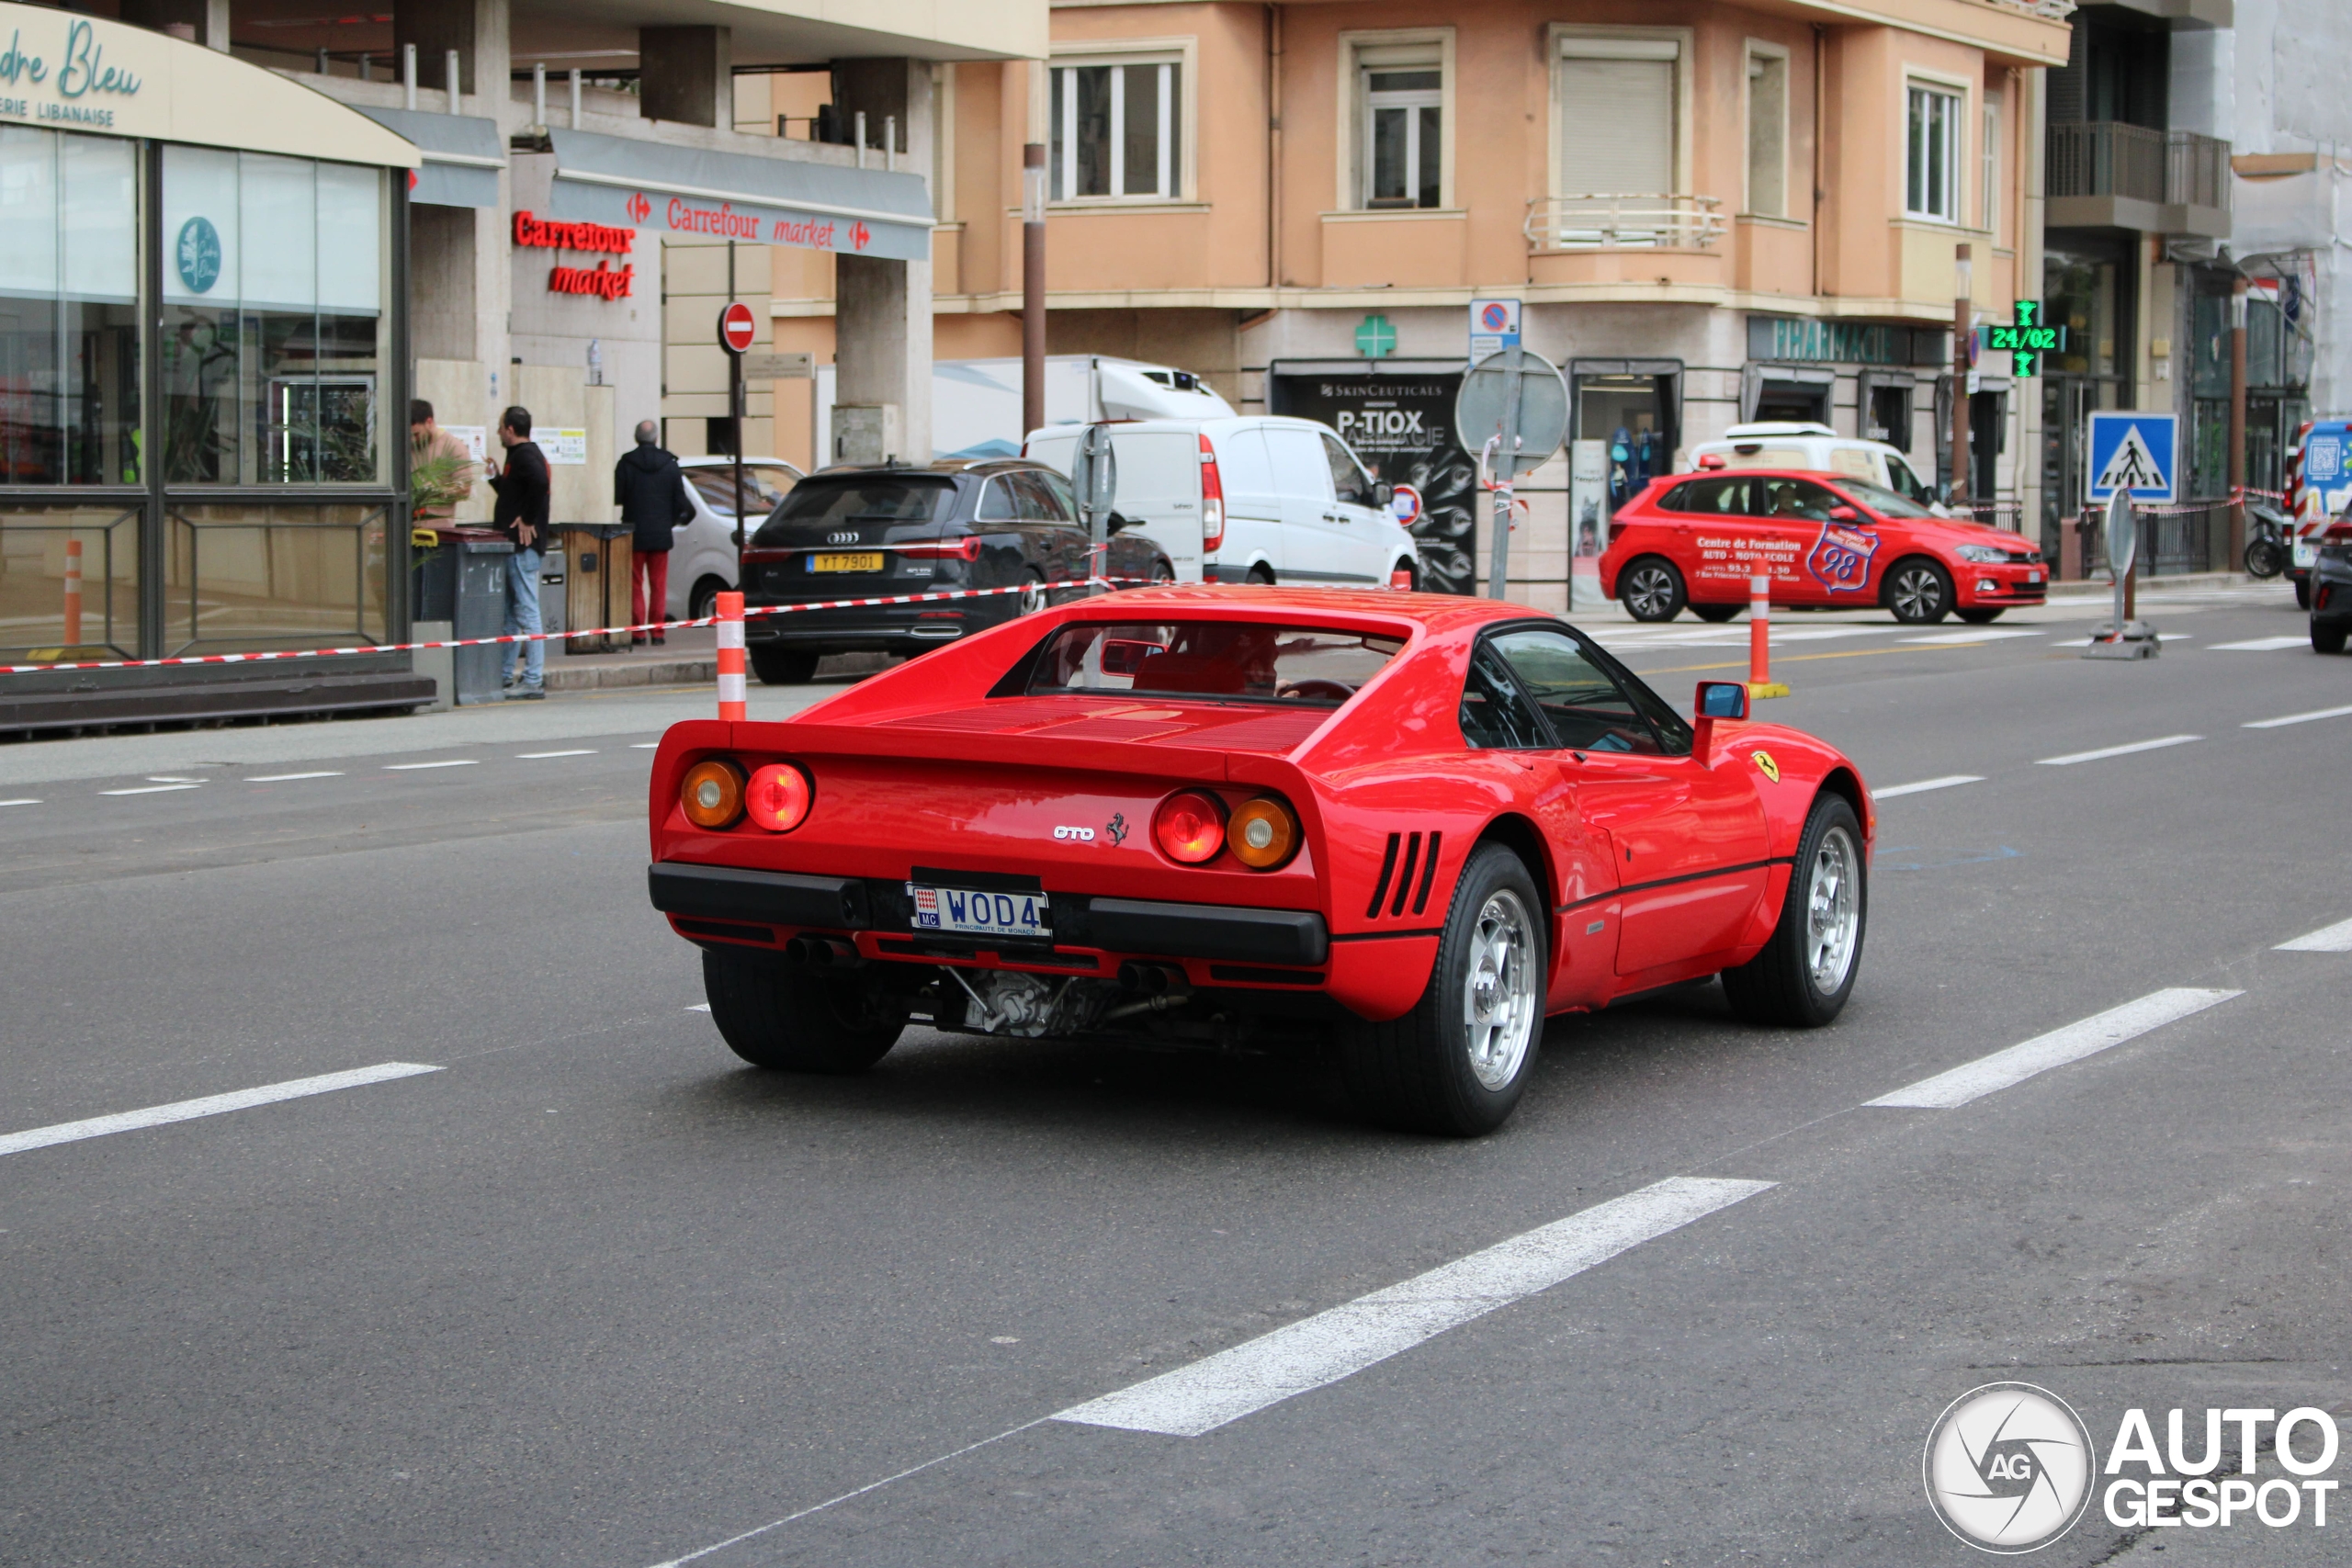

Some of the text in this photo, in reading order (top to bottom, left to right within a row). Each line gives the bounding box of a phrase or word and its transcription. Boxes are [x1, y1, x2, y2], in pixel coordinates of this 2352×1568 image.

[58, 18, 141, 97] Bleu
[38, 102, 114, 127] LIBANAISE
[512, 209, 636, 254] Carrefour
[666, 197, 835, 249] Carrefour market
[548, 259, 635, 301] market
[1774, 320, 1894, 363] PHARMACIE
[1992, 328, 2056, 348] 24/02
[1337, 411, 1423, 434] P-TIOX
[1697, 536, 1801, 551] Centre de Formation
[1702, 550, 1726, 559] AUTO
[823, 555, 874, 569] YT 7901
[1823, 547, 1858, 581] 98
[1054, 826, 1094, 841] GTO
[922, 915, 936, 925] MC
[946, 890, 1040, 929] WOD4
[956, 924, 995, 932] PRINCIPAUTE
[1009, 928, 1035, 936] MONACO
